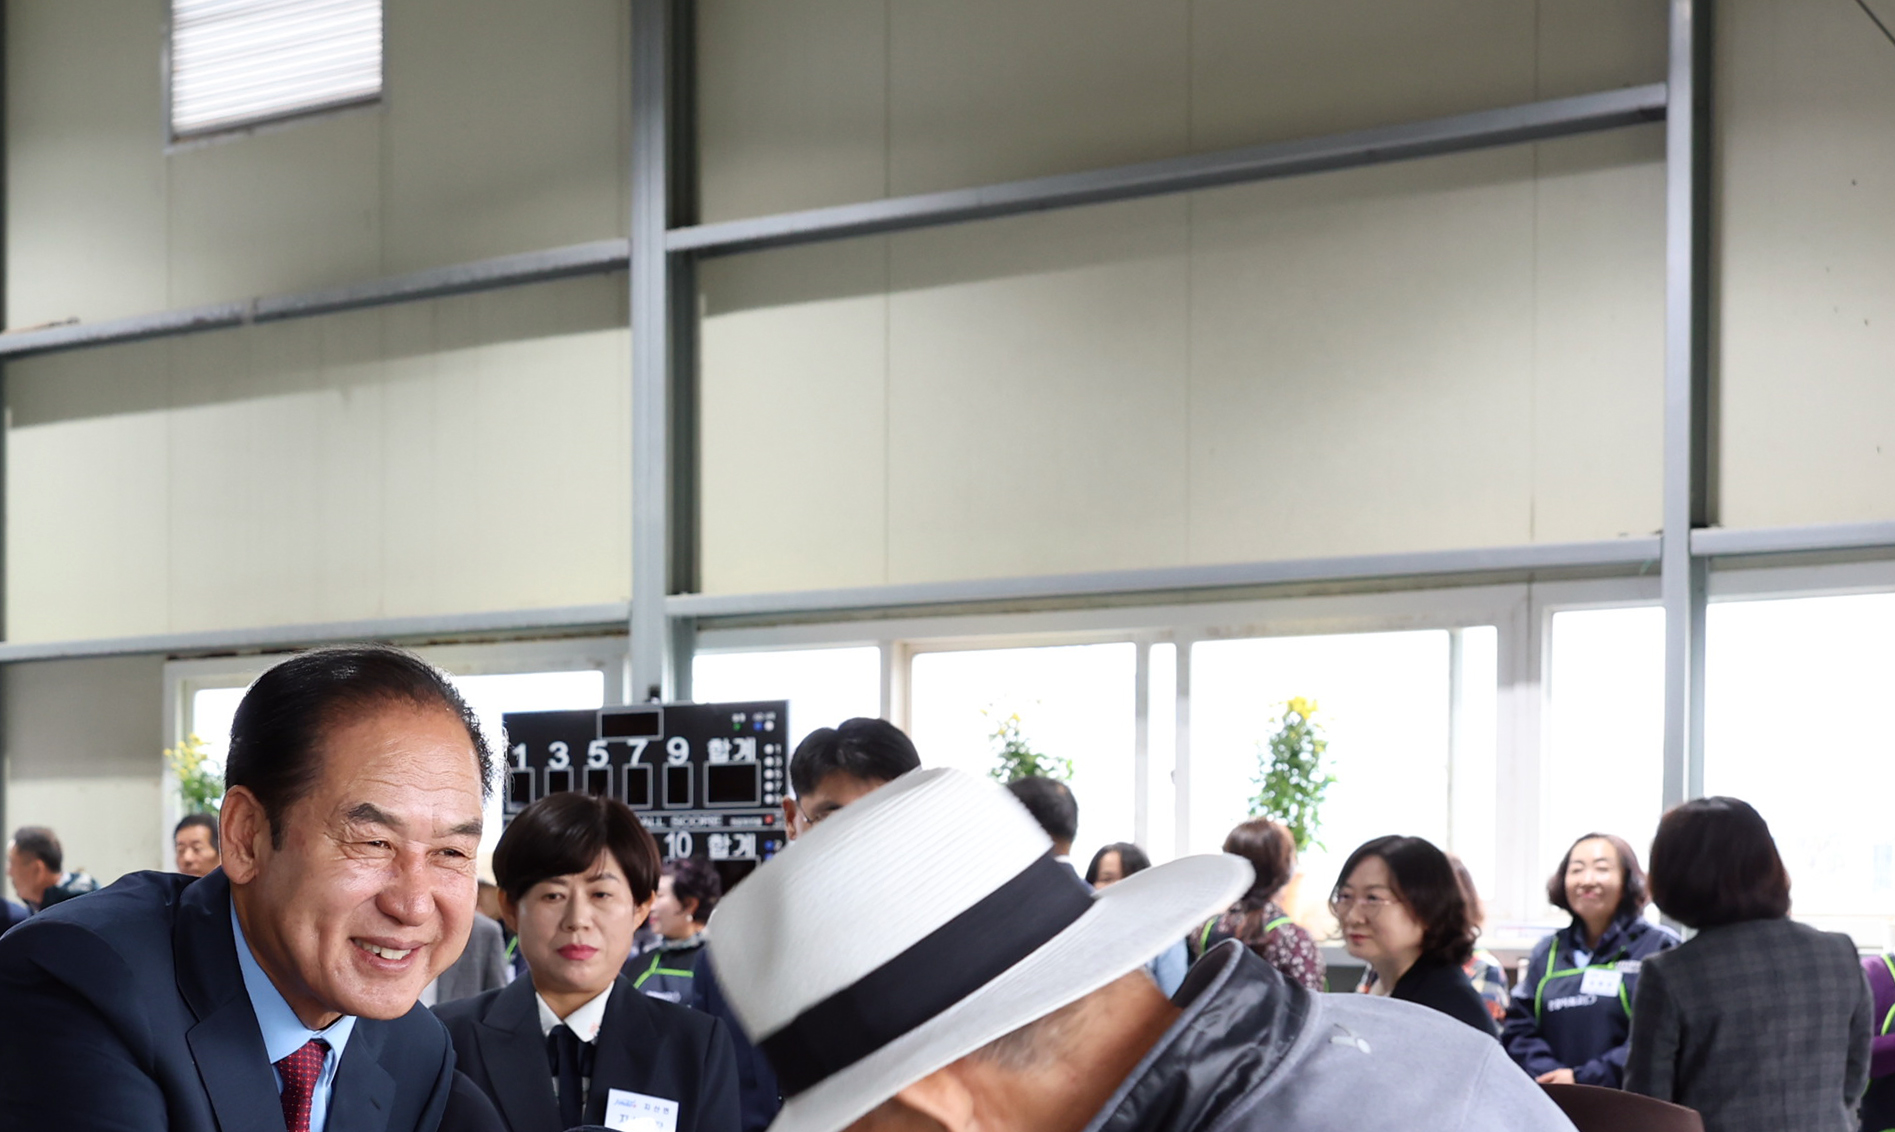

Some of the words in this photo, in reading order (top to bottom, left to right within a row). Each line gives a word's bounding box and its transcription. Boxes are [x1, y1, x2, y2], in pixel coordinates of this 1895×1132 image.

[512, 742, 527, 770] 1
[548, 741, 570, 770] 3
[587, 739, 609, 768] 5
[626, 738, 648, 766] 7
[666, 736, 690, 765] 9
[707, 737, 756, 764] 합계
[664, 831, 693, 859] 10
[707, 833, 756, 859] 합계
